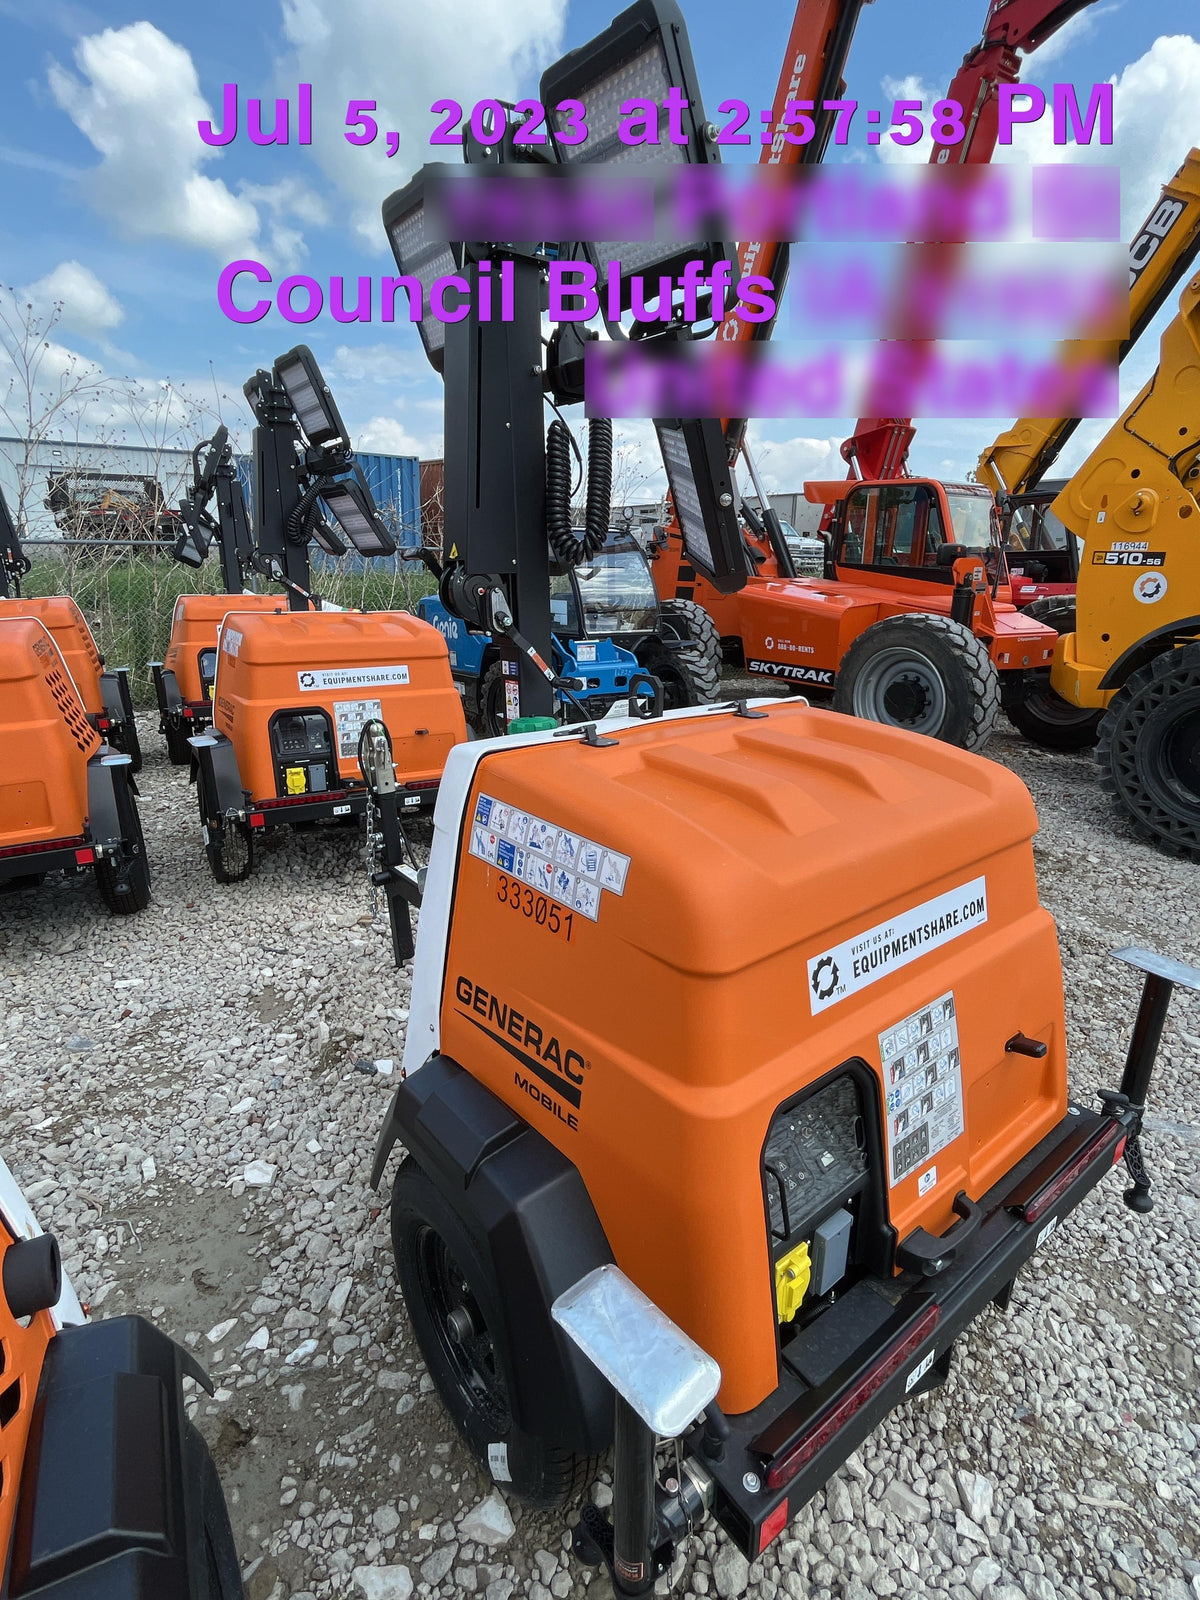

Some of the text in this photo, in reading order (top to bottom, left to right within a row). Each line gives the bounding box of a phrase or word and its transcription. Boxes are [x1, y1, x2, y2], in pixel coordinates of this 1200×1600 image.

[1104, 552, 1162, 566] 510-56
[1112, 542, 1149, 551] 116944
[323, 673, 408, 685] EQUIPMENTSHARE.COM
[749, 661, 833, 684] SKYTRAK
[497, 875, 574, 942] 333051
[851, 928, 895, 956] VISIT US AT:
[852, 896, 985, 979] EQUIPMENTSHARE.COM
[836, 984, 847, 995] TM
[456, 975, 585, 1086] GENERAC
[514, 1071, 579, 1133] MOBILE
